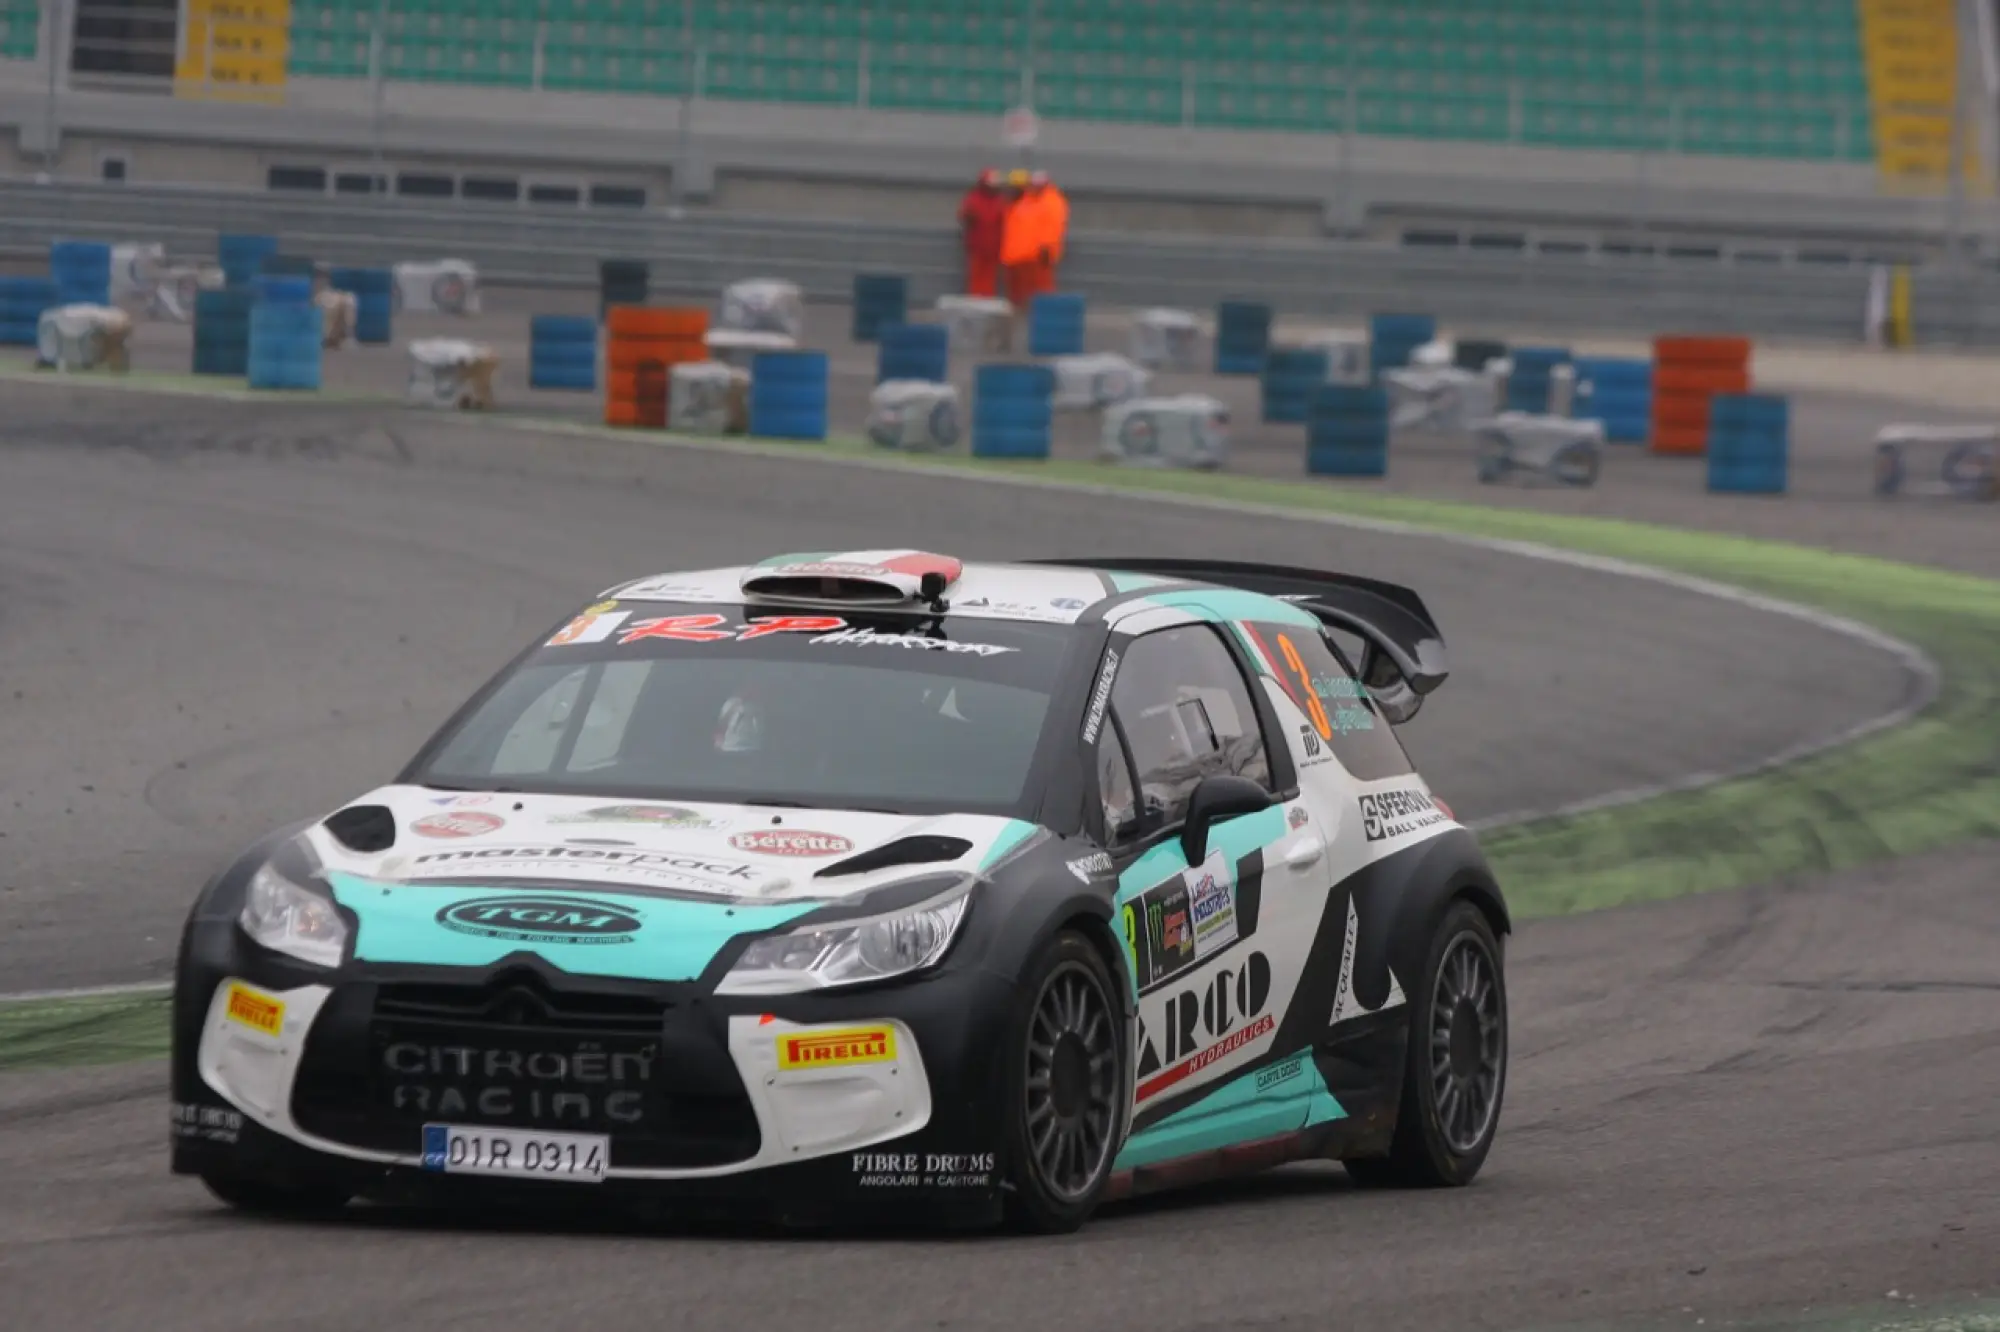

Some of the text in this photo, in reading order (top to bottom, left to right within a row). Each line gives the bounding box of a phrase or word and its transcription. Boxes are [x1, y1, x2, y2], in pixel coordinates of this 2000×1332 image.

[1277, 633, 1332, 740] 3
[1386, 822, 1416, 837] BALL
[738, 834, 847, 851] Beretta
[415, 847, 762, 880] masterpack
[475, 907, 616, 927] TGM
[786, 1032, 887, 1063] PIRELLI
[1188, 1016, 1271, 1074] HYDRAULICS
[451, 1136, 601, 1176] 01R 0314
[852, 1153, 995, 1173] FIBRE DRUMS
[859, 1174, 919, 1187] ANGOLARI
